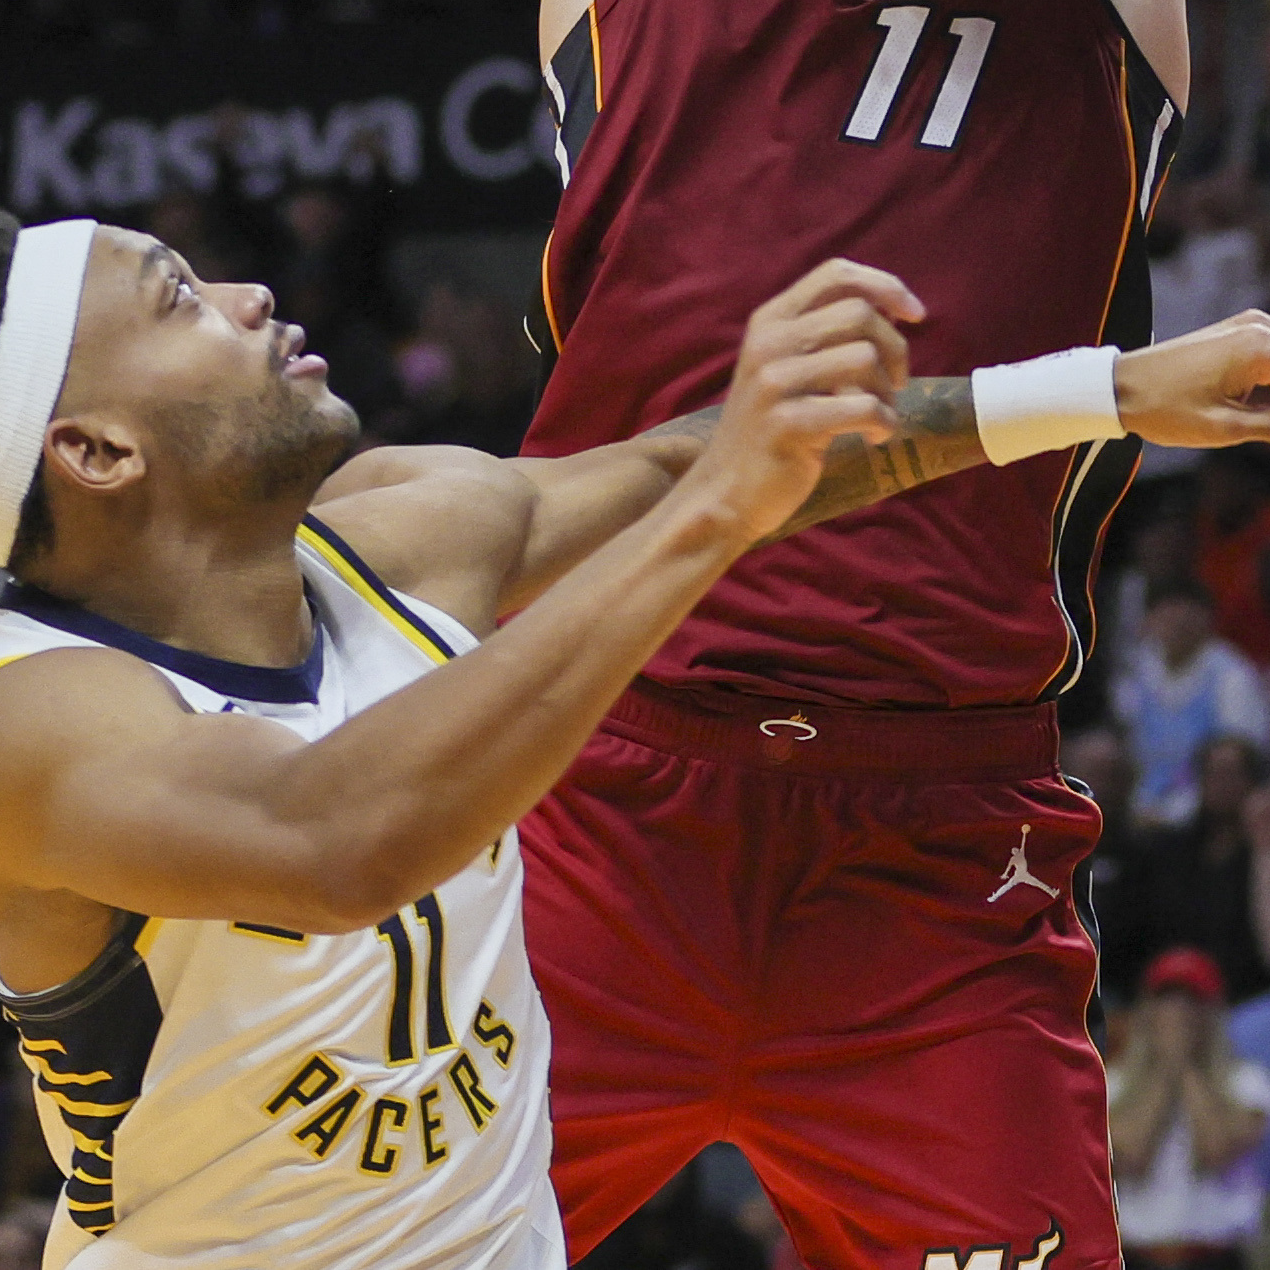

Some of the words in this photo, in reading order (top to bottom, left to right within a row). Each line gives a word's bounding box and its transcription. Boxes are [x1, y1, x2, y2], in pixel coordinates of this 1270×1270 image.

[842, 4, 996, 148] 11
[374, 889, 462, 1068] 11
[261, 997, 517, 1178] PACERS
